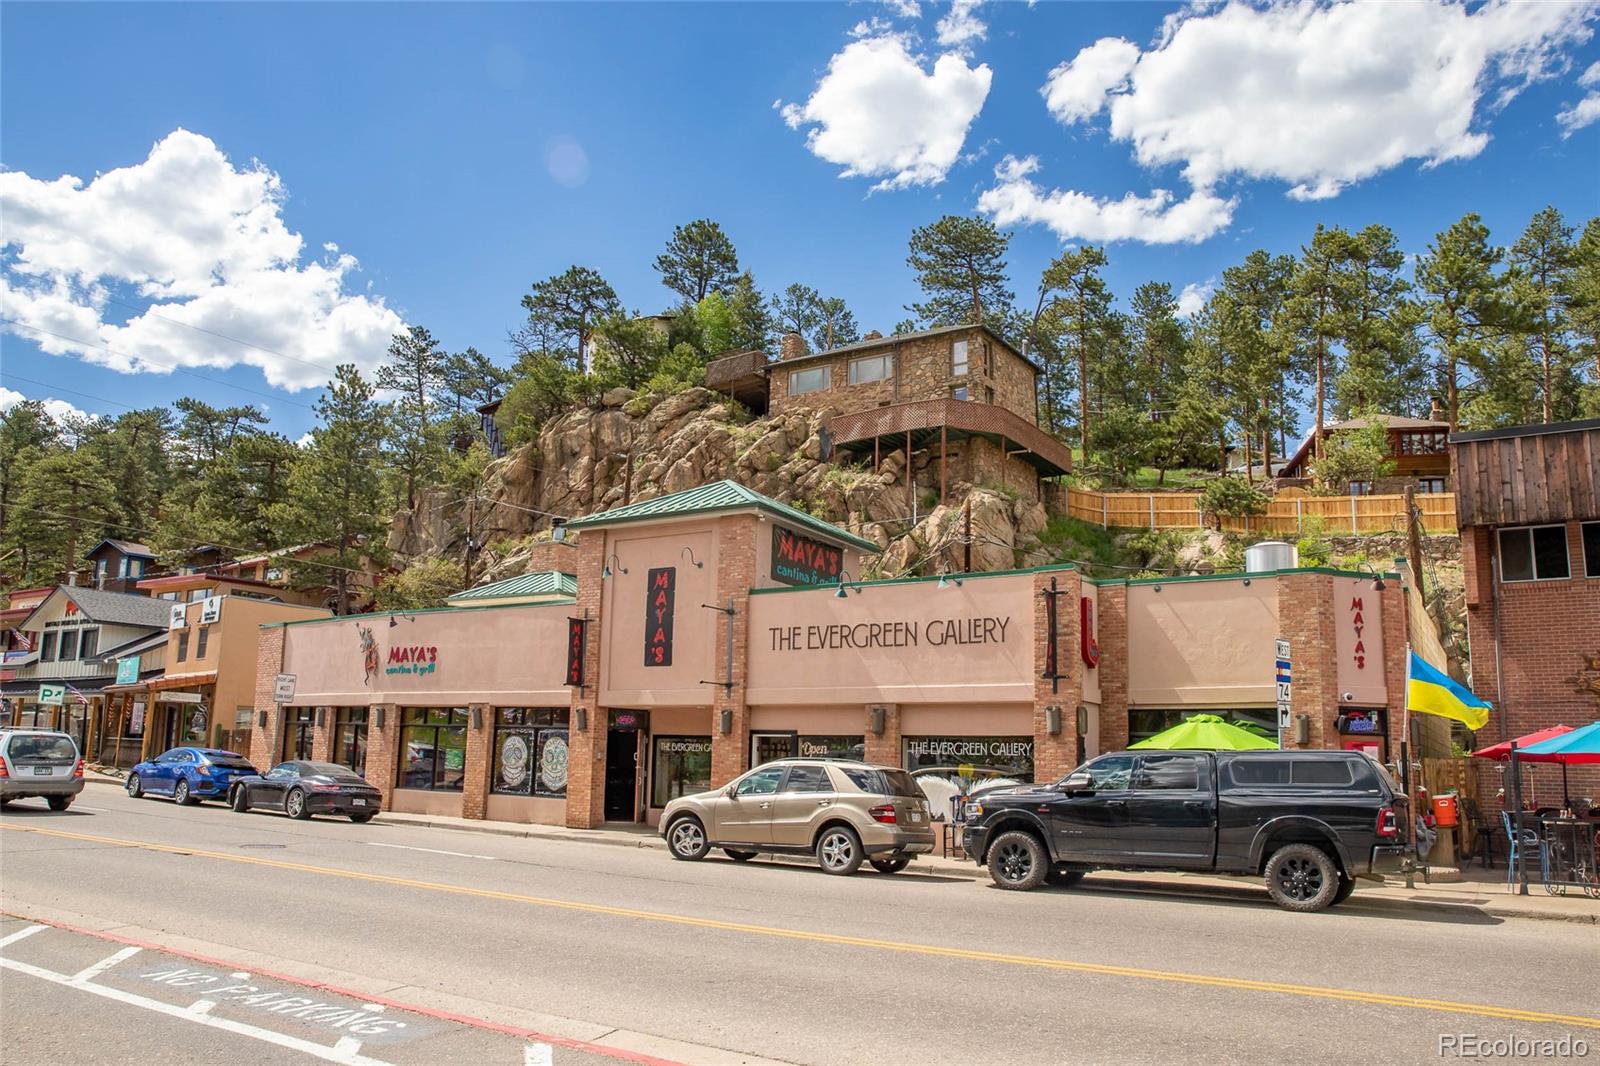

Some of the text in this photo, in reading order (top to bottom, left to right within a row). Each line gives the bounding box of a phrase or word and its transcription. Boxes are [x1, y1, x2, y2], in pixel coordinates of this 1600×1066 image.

[777, 534, 838, 575] MAYA'S
[776, 565, 809, 583] cantina
[811, 569, 818, 584] &
[651, 571, 669, 664] MAYA'S
[769, 616, 1010, 650] THE EVERGREEN GALLERY
[1350, 596, 1365, 670] MAYA'S
[387, 646, 438, 664] MAYA'S
[1277, 642, 1290, 657] WEST
[1279, 683, 1289, 699] 74
[660, 742, 671, 752] THE
[671, 742, 703, 752] EVERGREEN
[802, 741, 829, 758] Open
[910, 741, 1032, 756] THE EVERGREEN GALLERY
[140, 969, 406, 1034] NO PARKING
